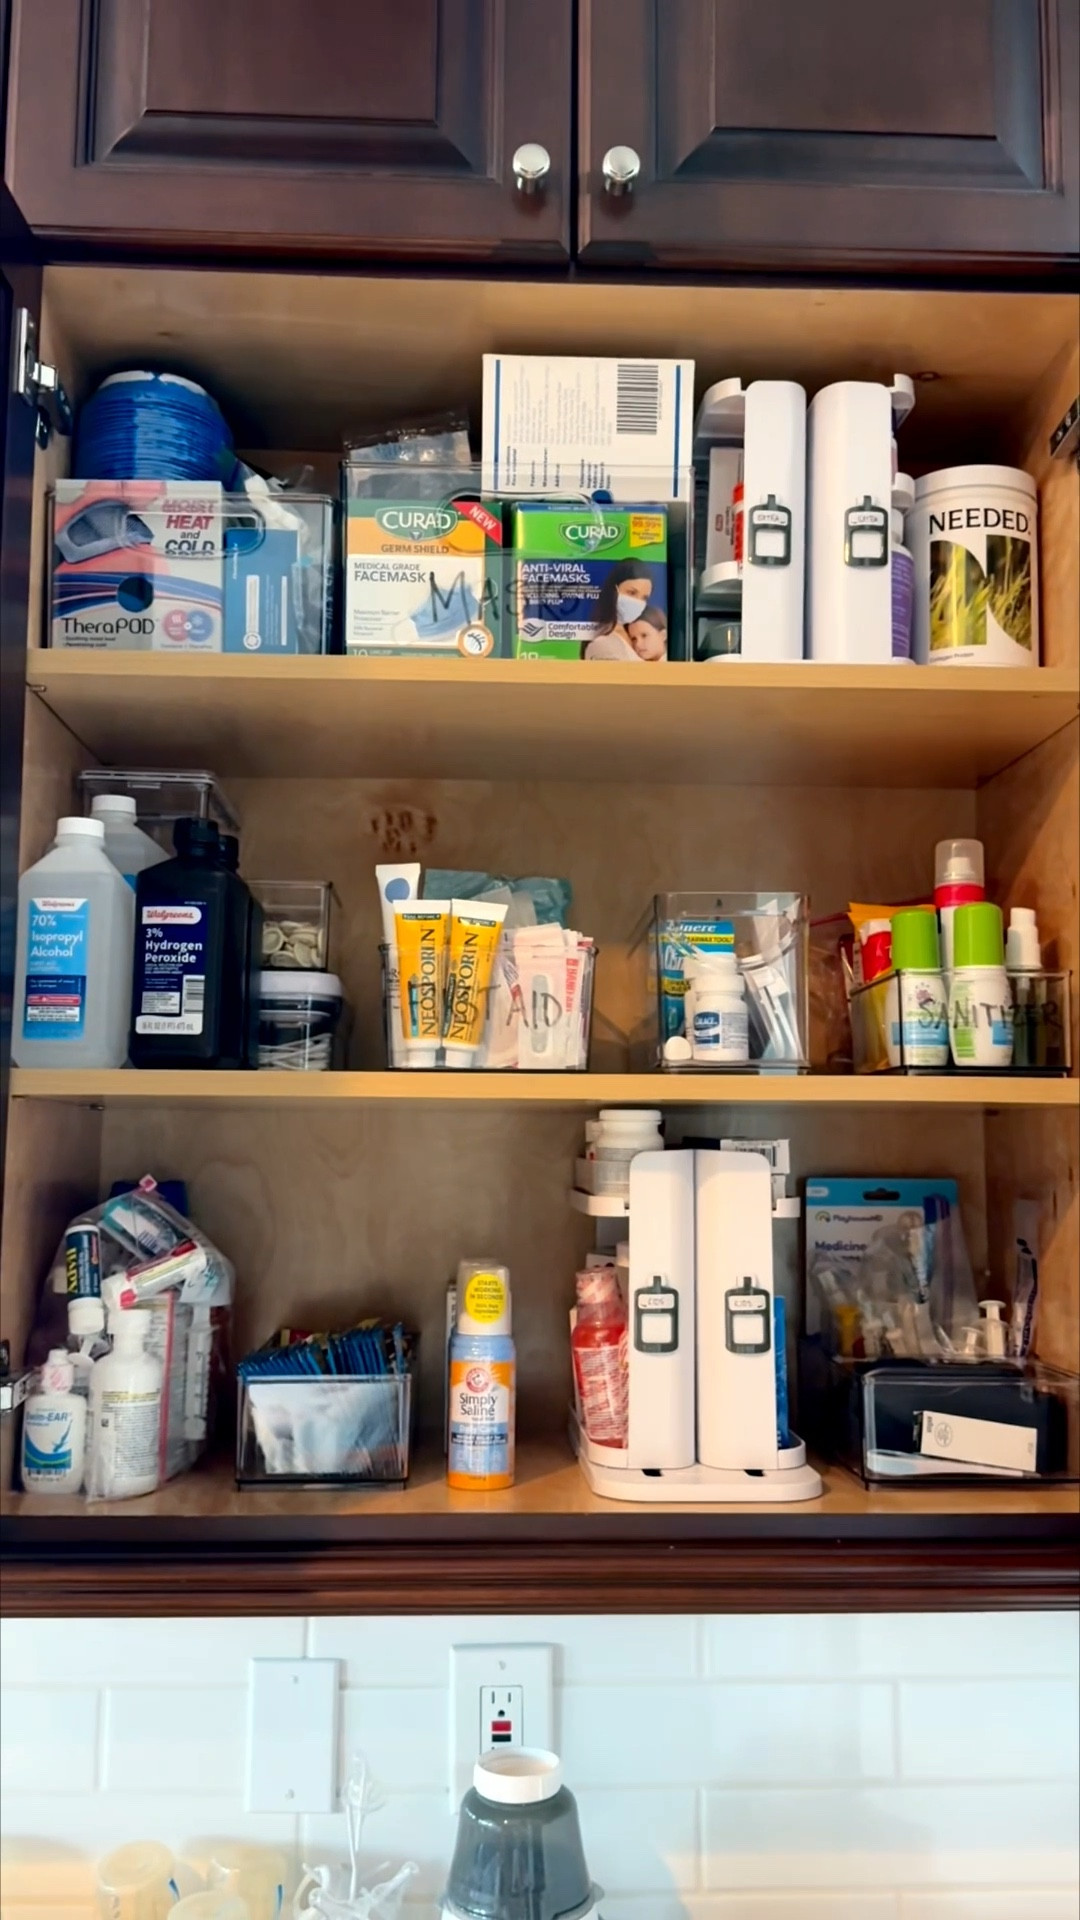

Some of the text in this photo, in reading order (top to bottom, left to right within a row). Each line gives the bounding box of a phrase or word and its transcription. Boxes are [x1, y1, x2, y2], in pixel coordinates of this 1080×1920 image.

[166, 515, 214, 530] HEAT
[382, 511, 451, 530] CURAD
[469, 505, 497, 531] NEW
[180, 531, 200, 540] and
[565, 525, 618, 540] CURAD
[165, 540, 215, 556] COLD
[381, 544, 450, 554] GERM SHIELD
[354, 562, 421, 571] MEDICAL GRADE
[523, 563, 586, 574] ANTI-VIRAL
[354, 571, 426, 583] FACEMASK
[61, 618, 156, 635] TheraPOD
[548, 632, 577, 640] Design
[32, 914, 57, 927] 70%
[147, 910, 194, 920] Walgreens
[32, 930, 83, 946] Isopropyl
[146, 928, 164, 938] 3%
[30, 946, 73, 957] Alcohol
[146, 941, 203, 954] Hydrogen
[145, 953, 197, 964] Peroxide
[420, 928, 437, 1036] NEOSPORIN
[449, 931, 479, 1040] NEOSPORIN
[506, 984, 563, 1029] AID
[815, 1241, 868, 1251] Medicine
[460, 1393, 498, 1408] Simply
[461, 1404, 496, 1416] Saline
